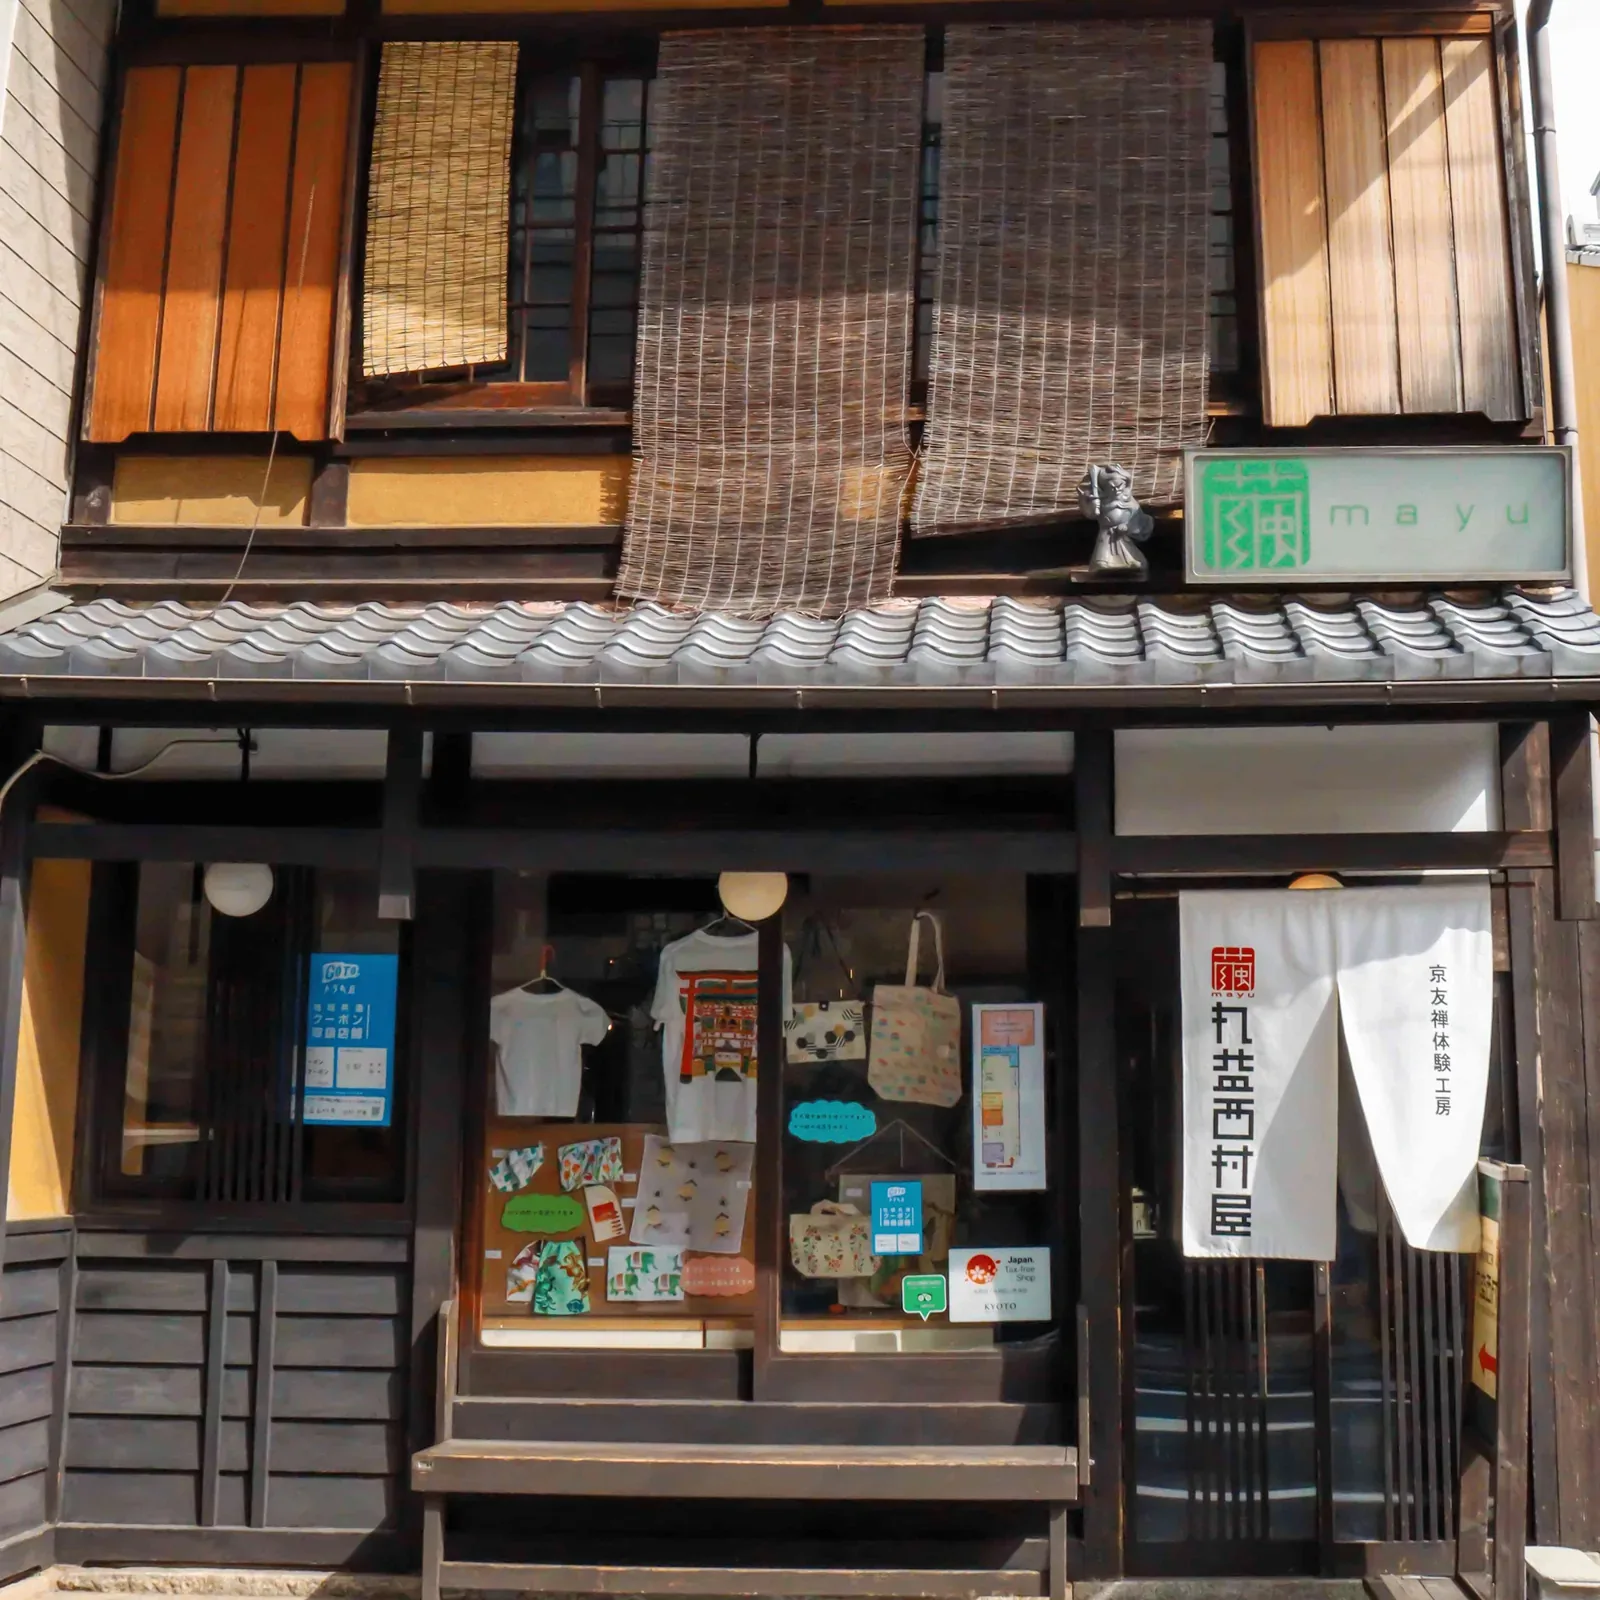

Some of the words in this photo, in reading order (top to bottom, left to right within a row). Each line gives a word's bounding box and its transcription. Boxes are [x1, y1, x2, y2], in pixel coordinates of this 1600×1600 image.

[313, 1014, 363, 1026] クーポン
[1429, 964, 1452, 1116] 京友禅体験工房
[984, 1302, 1017, 1311] KYOTO
